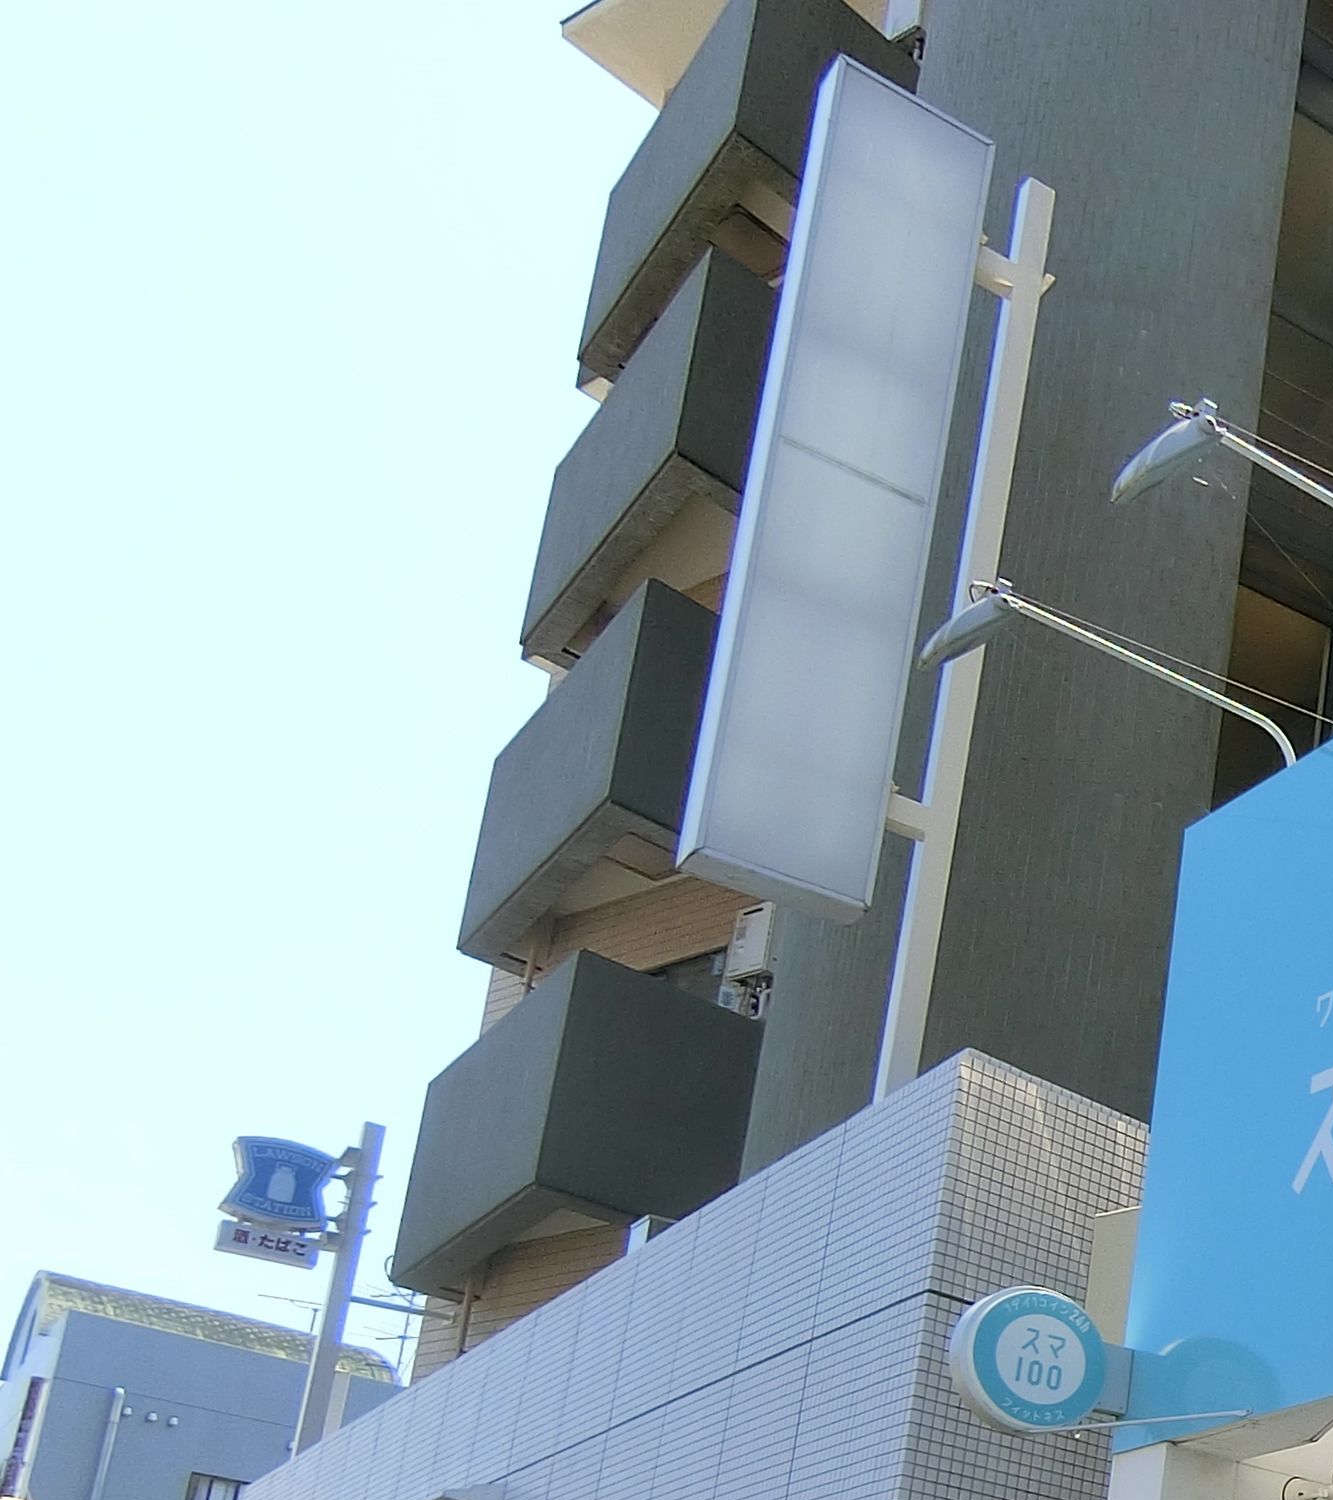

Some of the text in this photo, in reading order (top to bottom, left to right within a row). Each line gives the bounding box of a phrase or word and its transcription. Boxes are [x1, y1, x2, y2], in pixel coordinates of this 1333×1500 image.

[253, 1146, 323, 1172] LAWSON
[240, 1192, 312, 1217] STATION
[1021, 1327, 1067, 1359] スマ
[1015, 1356, 1062, 1391] 100
[1002, 1397, 1065, 1420] フィットネス
